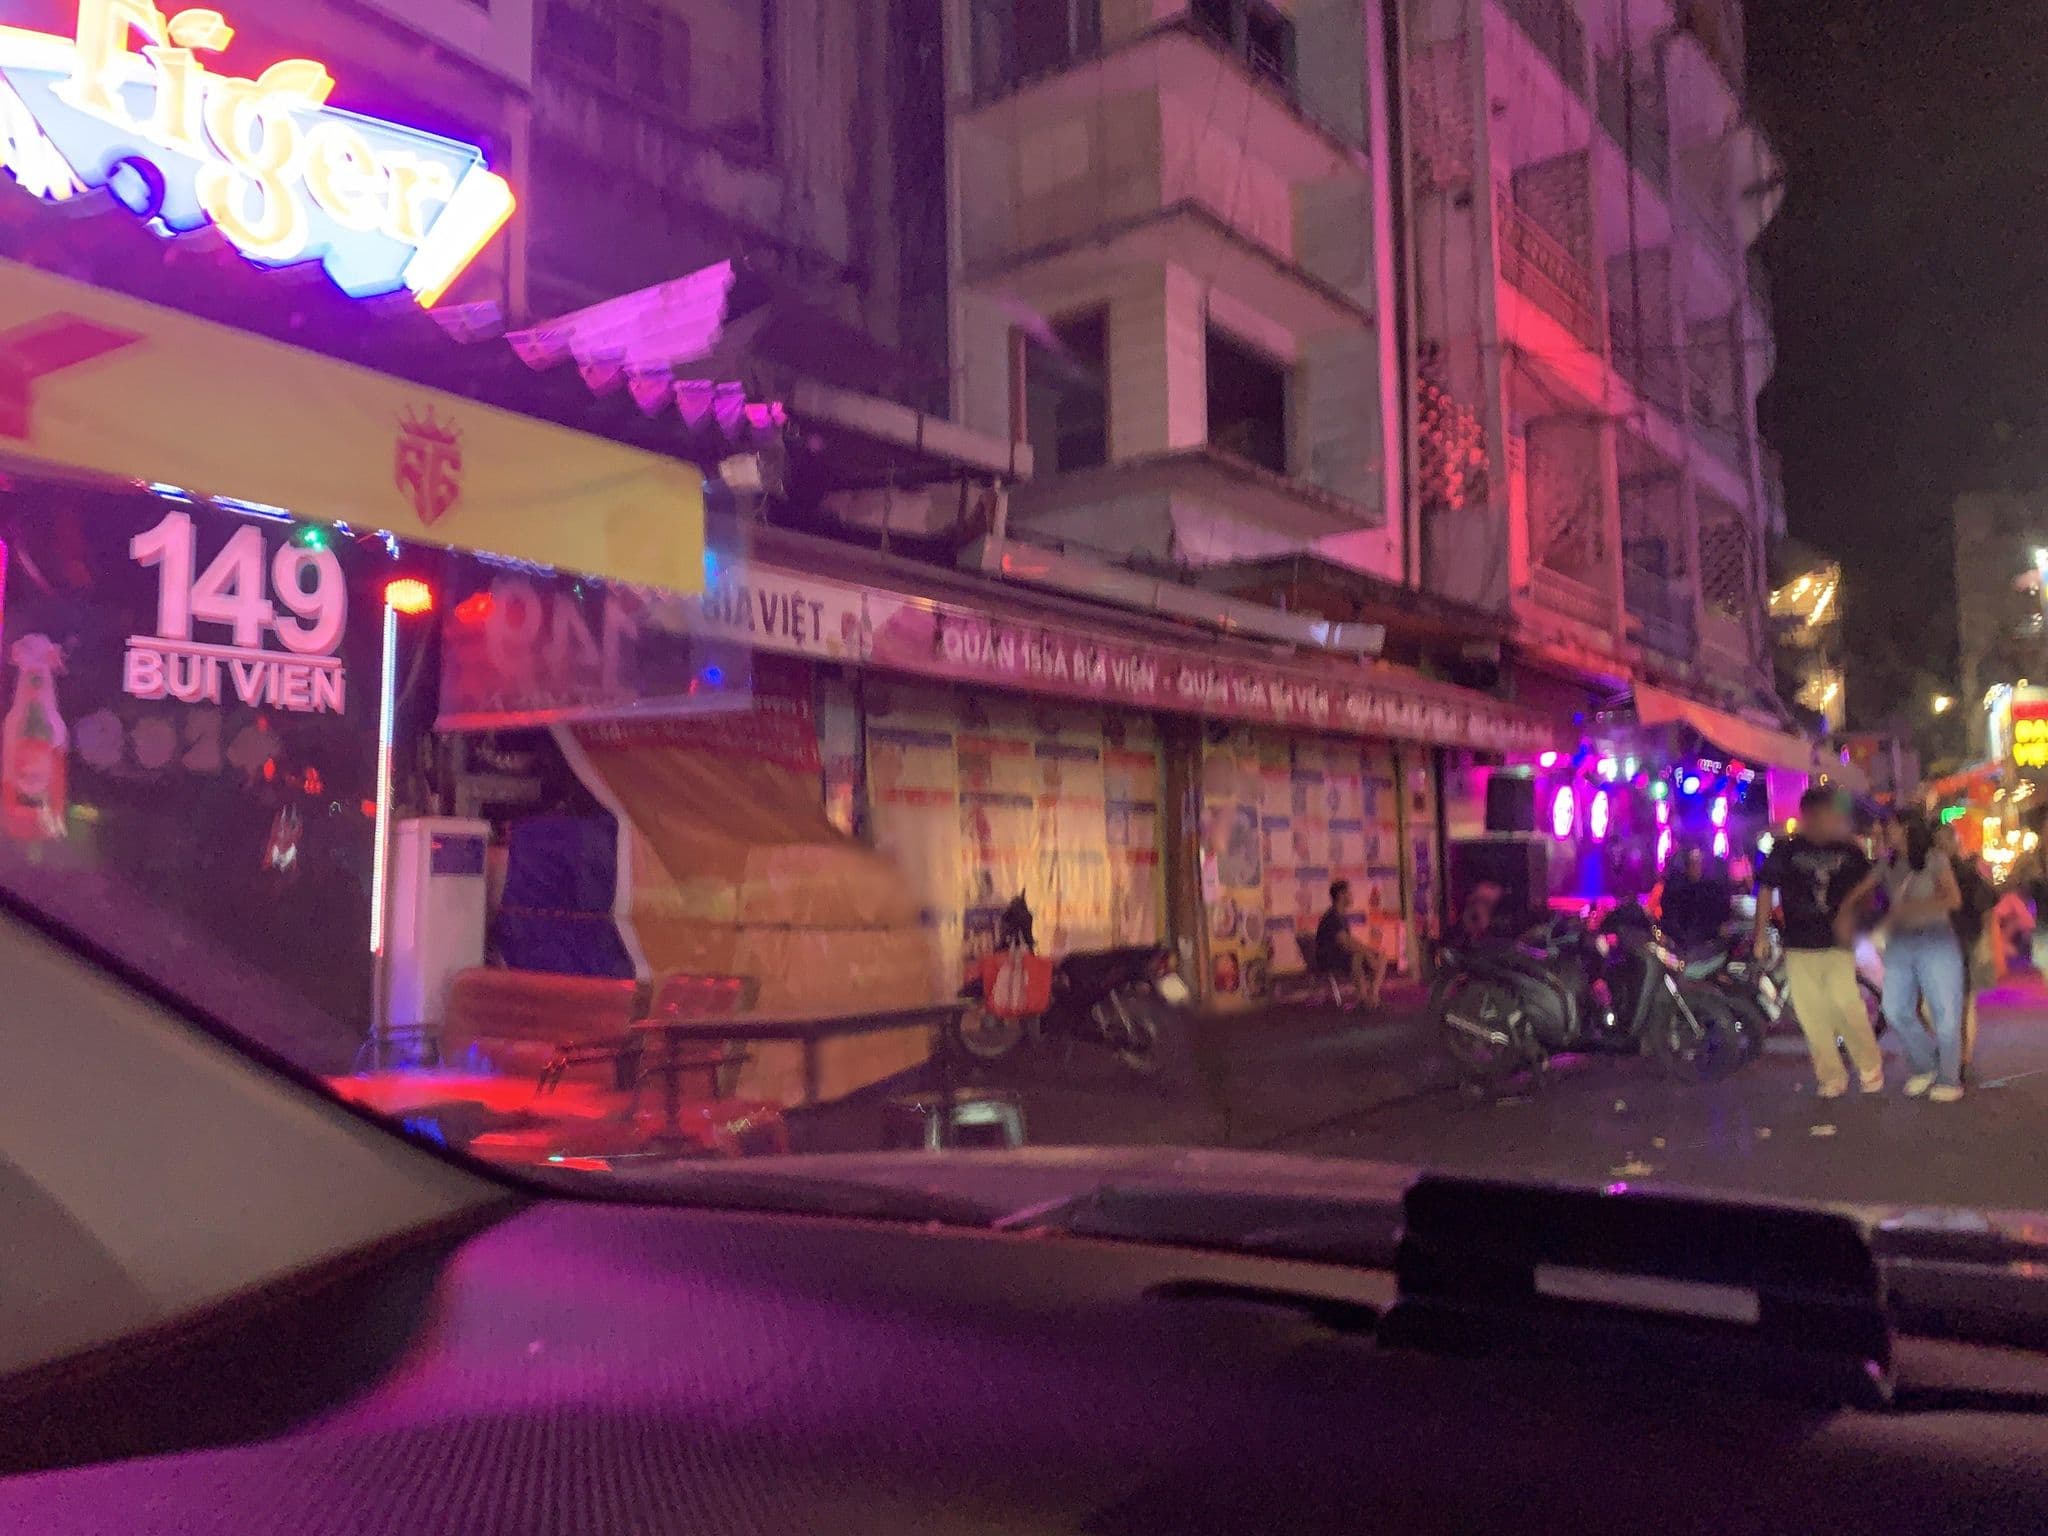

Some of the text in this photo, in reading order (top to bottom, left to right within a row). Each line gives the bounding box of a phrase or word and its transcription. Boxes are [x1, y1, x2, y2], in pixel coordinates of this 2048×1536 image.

[130, 510, 349, 657] 149
[122, 648, 346, 714] BUI VIEN
